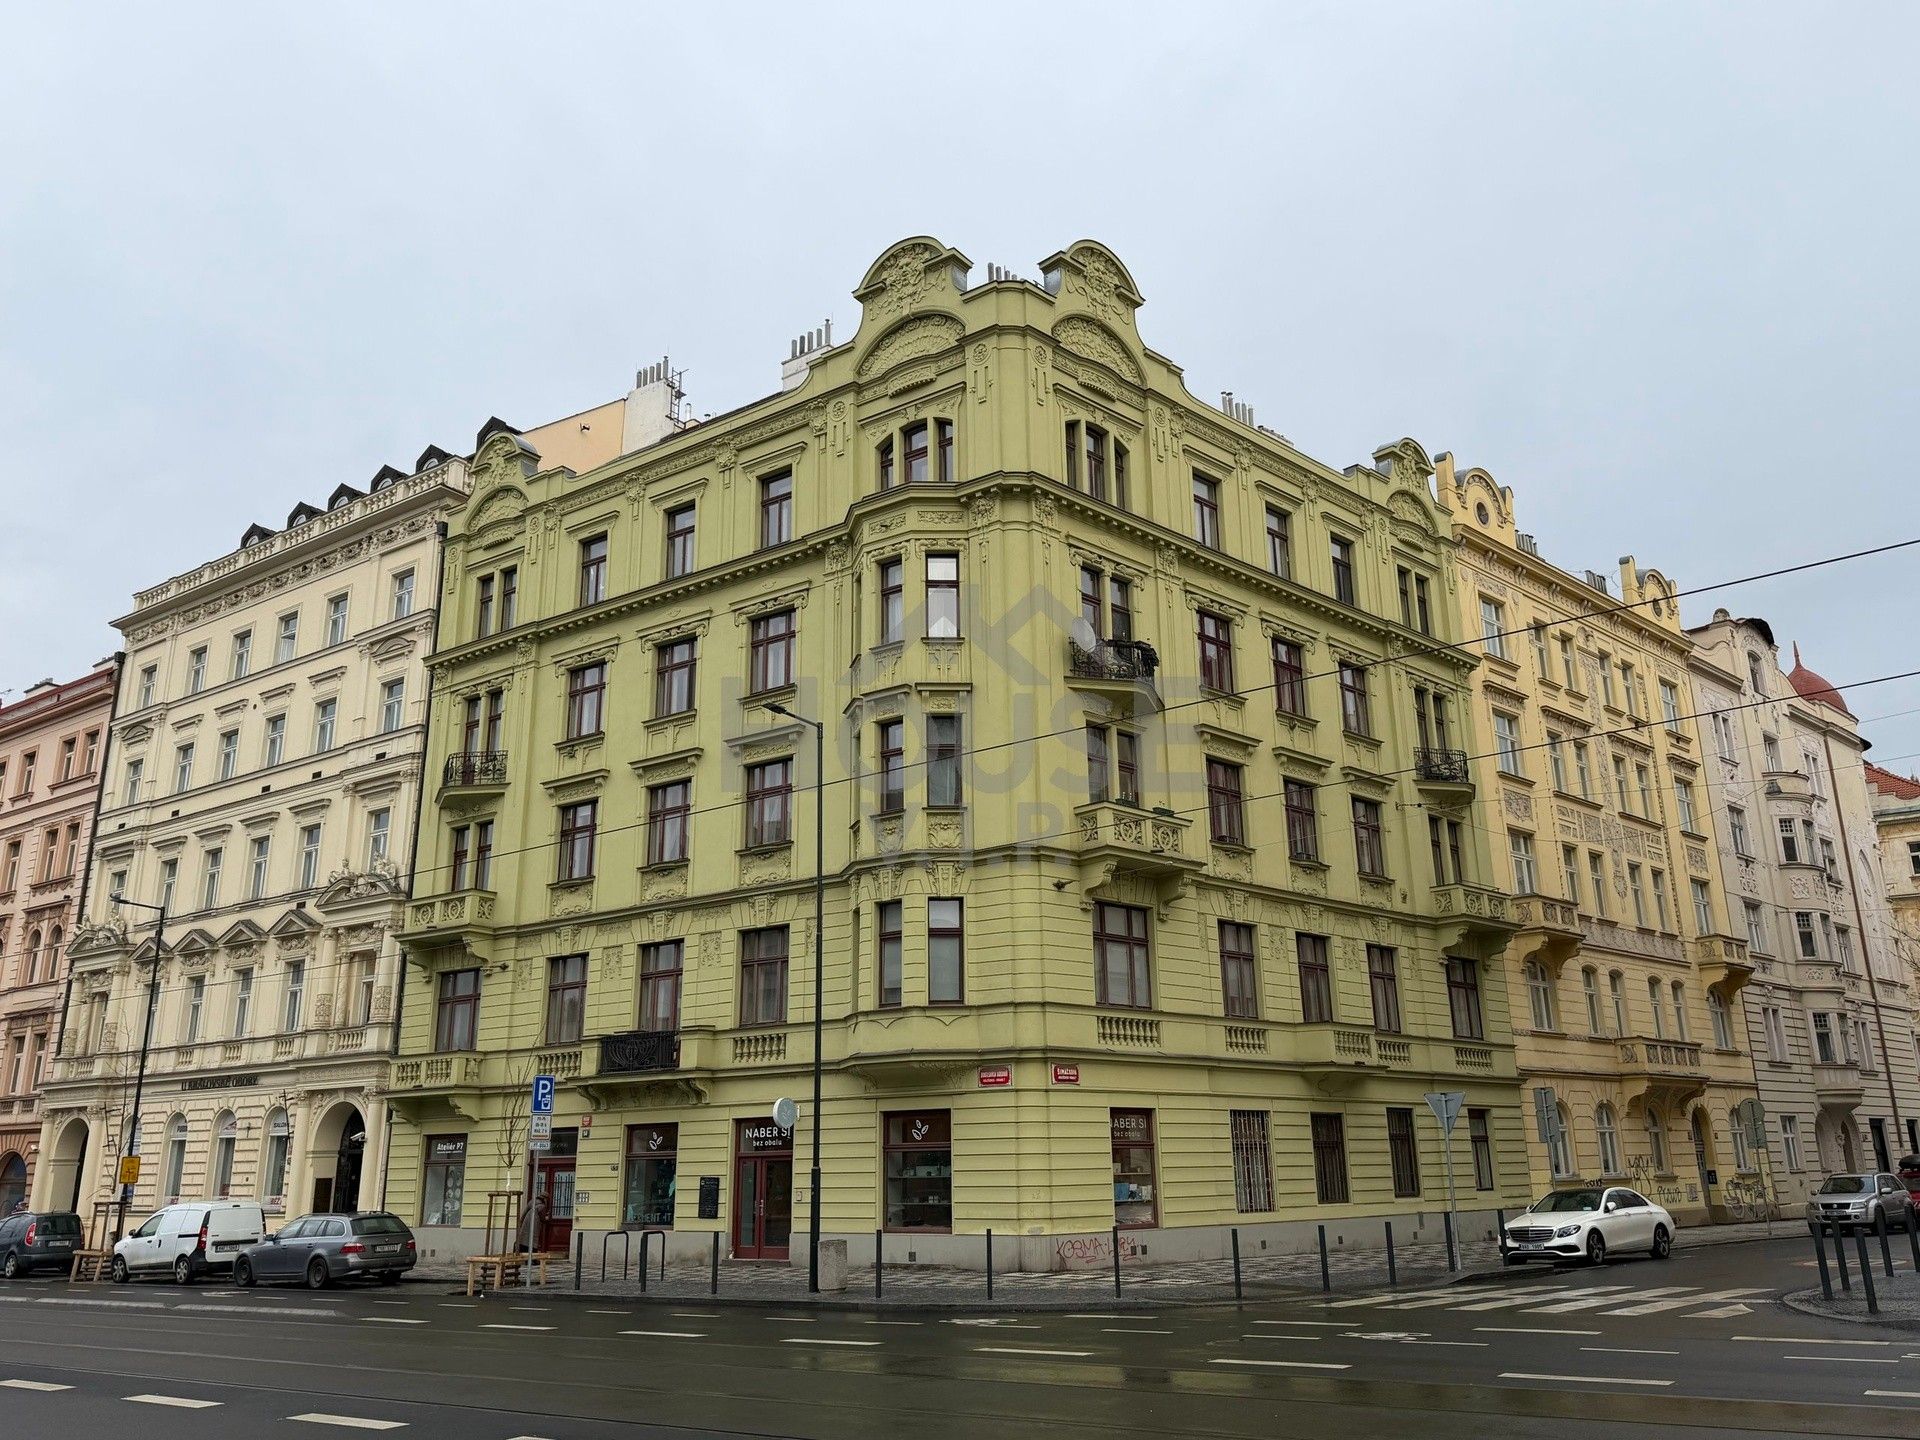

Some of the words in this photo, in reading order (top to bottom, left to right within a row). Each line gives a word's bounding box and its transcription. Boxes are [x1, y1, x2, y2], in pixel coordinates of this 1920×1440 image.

[538, 1080, 551, 1101] P
[745, 1127, 778, 1138] NABER
[781, 1127, 791, 1138] SI
[456, 1142, 464, 1150] P7
[752, 1139, 763, 1147] bez
[764, 1138, 782, 1146] obalu
